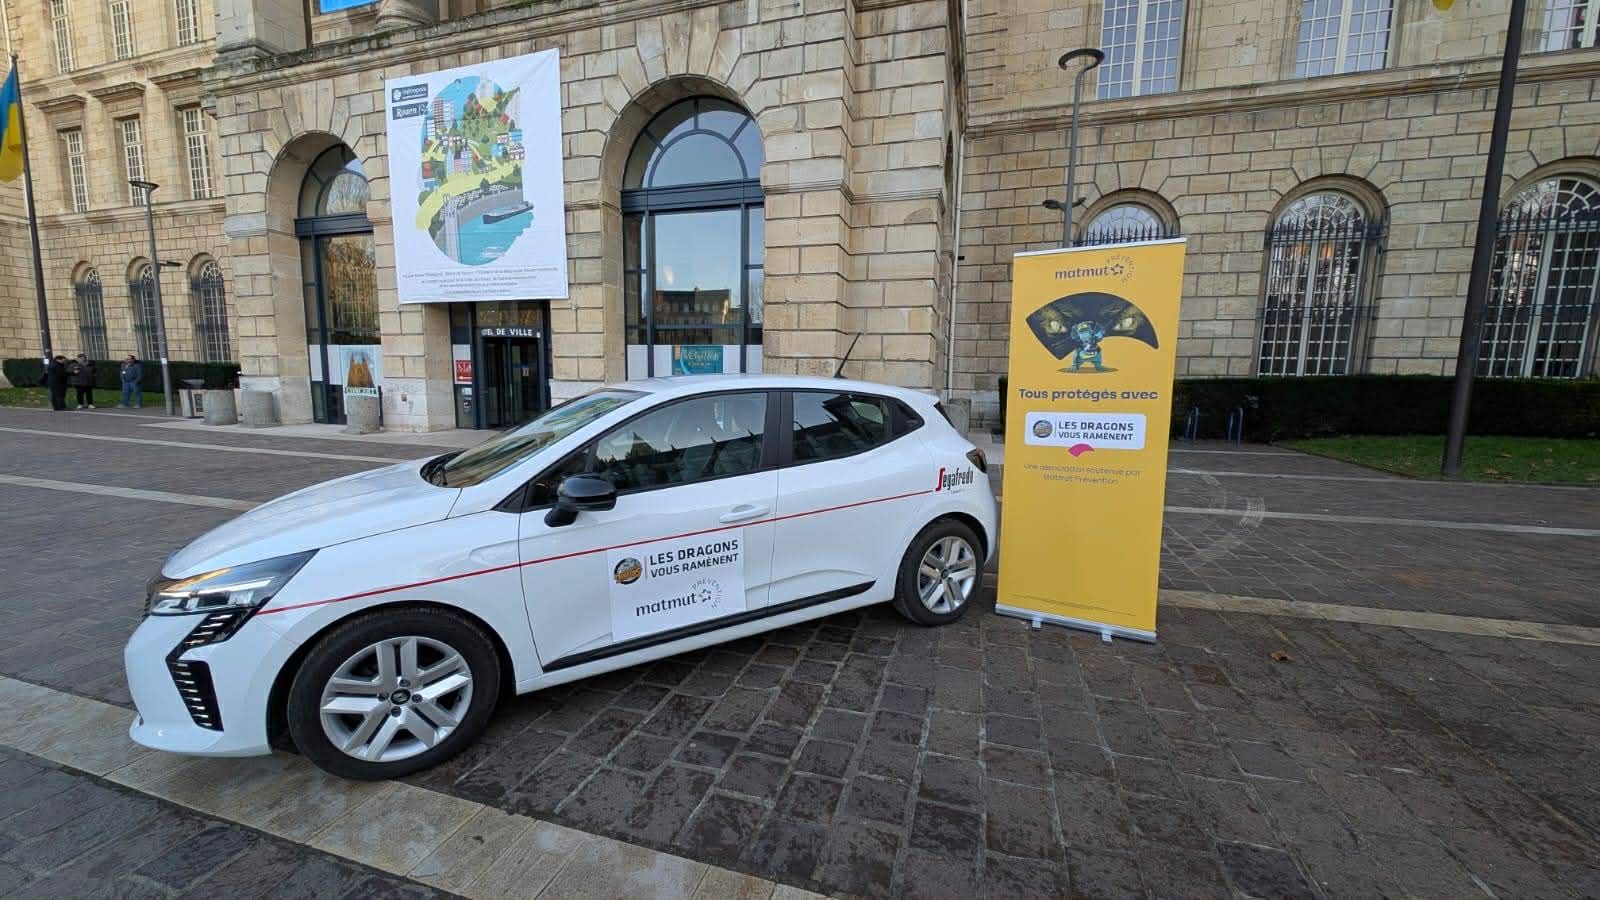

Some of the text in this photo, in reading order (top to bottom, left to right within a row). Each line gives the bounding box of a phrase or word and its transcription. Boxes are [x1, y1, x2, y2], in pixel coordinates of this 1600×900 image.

[1055, 266, 1109, 280] matmut
[496, 328, 505, 336] DE
[510, 328, 533, 336] VILLE
[1019, 388, 1159, 402] Tous protégés avec
[1058, 421, 1134, 432] LES DRAGONS
[1058, 431, 1081, 439] VOUS
[935, 466, 974, 491] Segafredo
[1087, 467, 1123, 476] soutenue
[1126, 469, 1141, 478] par
[650, 540, 739, 566] LES DRAGONS
[651, 564, 680, 578] VOUS
[636, 592, 697, 617] matmut
